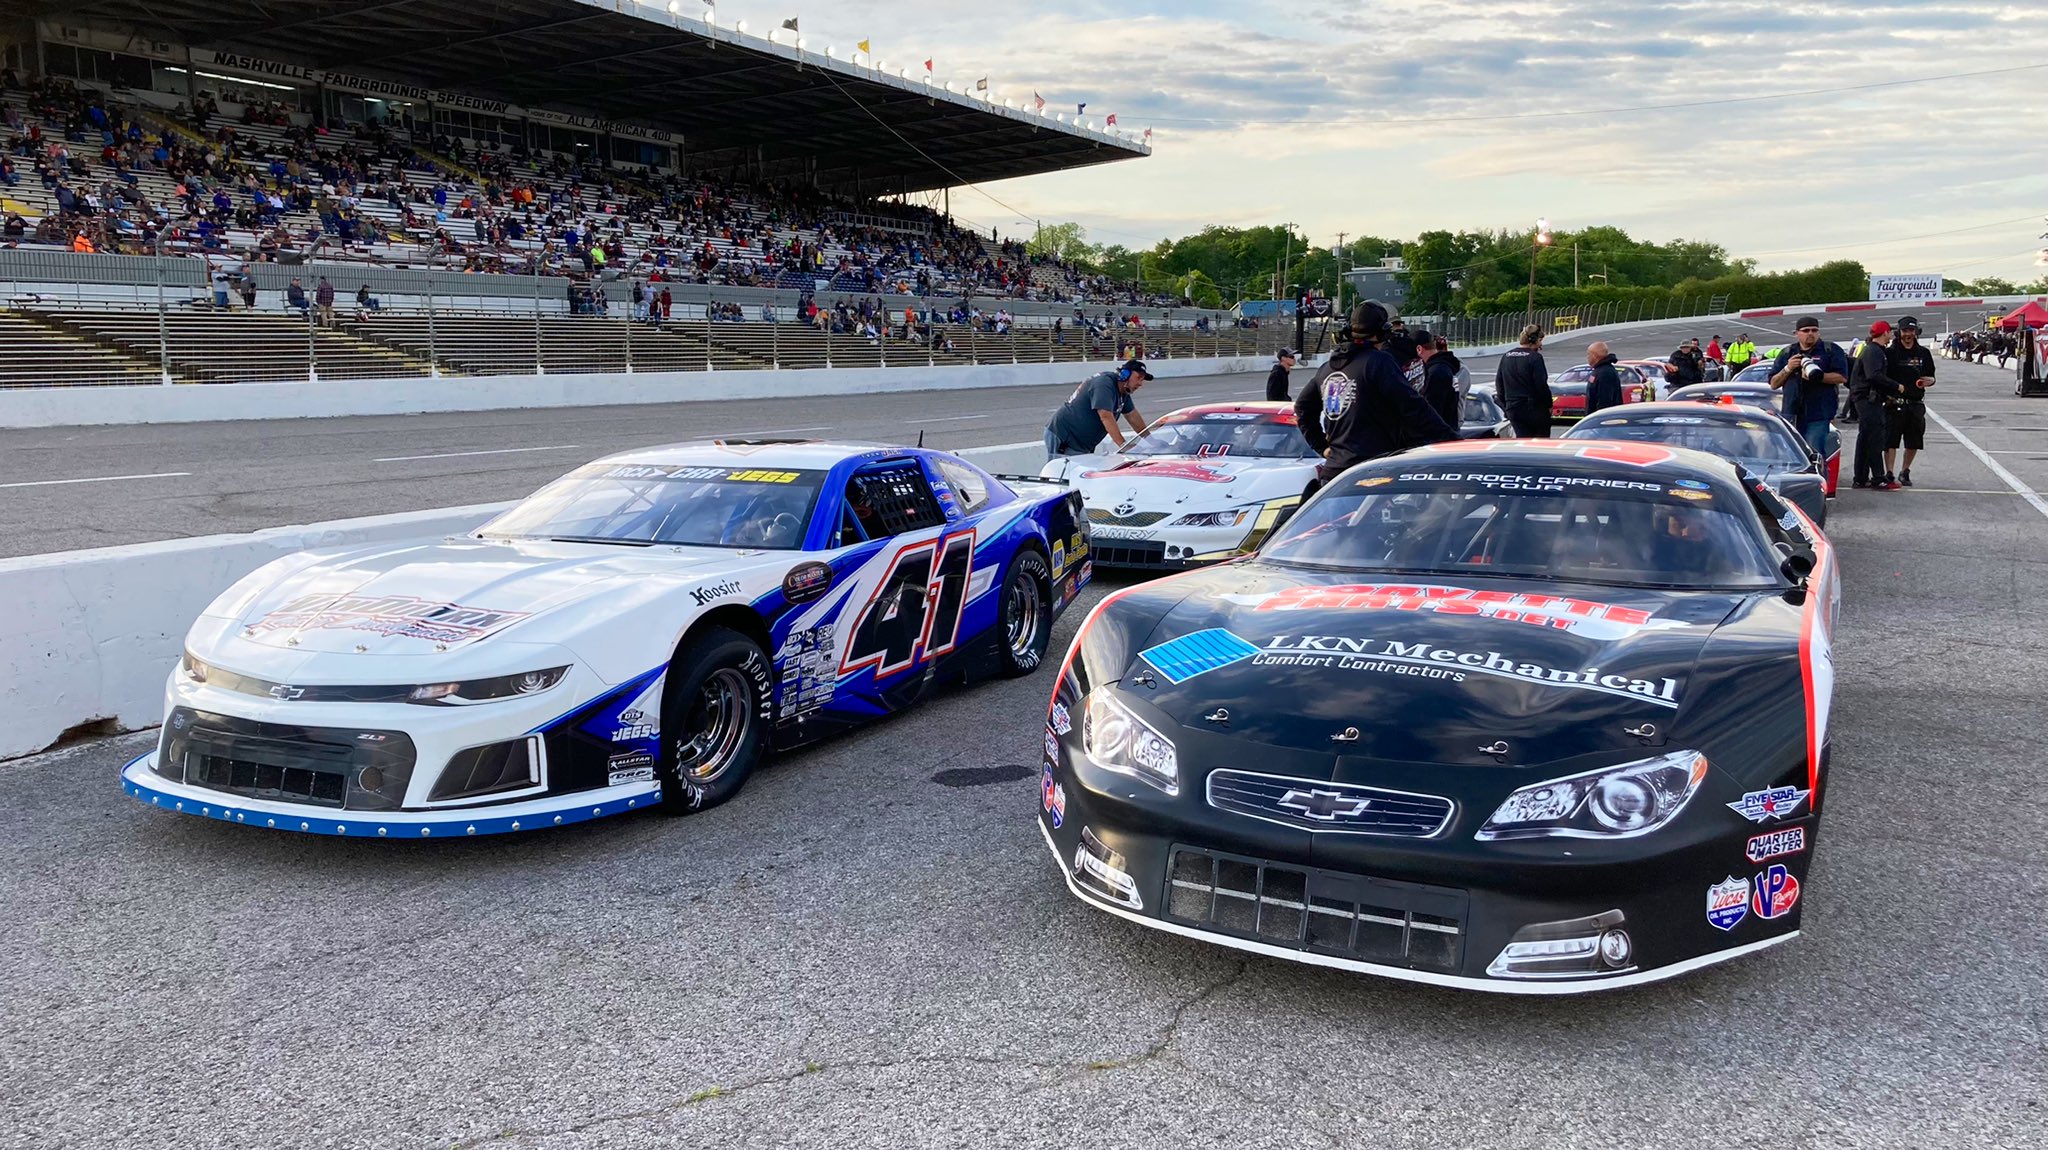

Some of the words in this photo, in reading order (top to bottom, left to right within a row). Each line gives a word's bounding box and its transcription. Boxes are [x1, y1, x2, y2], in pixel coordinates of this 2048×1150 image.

[213, 52, 313, 81] NASHVILLE
[566, 115, 587, 128] ALL
[590, 119, 647, 138] AMERICAN
[651, 130, 672, 142] 400
[1876, 280, 1937, 294] Fairgrounds
[603, 466, 649, 478] ARCA
[725, 470, 800, 484] JEGS
[1397, 473, 1461, 482] SOLID
[1465, 473, 1532, 484] ROCK
[1537, 476, 1662, 492] CARRIERS
[1481, 482, 1565, 492] TOUR
[689, 579, 742, 612] Hoosier
[838, 528, 977, 681] 41
[1275, 584, 1651, 626] CORVETTE
[1251, 652, 1334, 668] Comfort
[1338, 656, 1467, 683] Contractors
[1262, 635, 1375, 651] LKN
[1379, 640, 1678, 701] Mechanical
[611, 724, 652, 742] JEGS
[617, 756, 651, 765] ALLSTAR
[1745, 794, 1767, 808] FIVE
[1770, 789, 1795, 802] STAR
[1747, 828, 1802, 855] QUARTER
[1755, 838, 1802, 860] MASTER
[1712, 890, 1746, 909] LUCAS
[1755, 864, 1787, 918] VP
[1709, 911, 1719, 920] OIL
[1719, 905, 1746, 917] PRODUCTS
